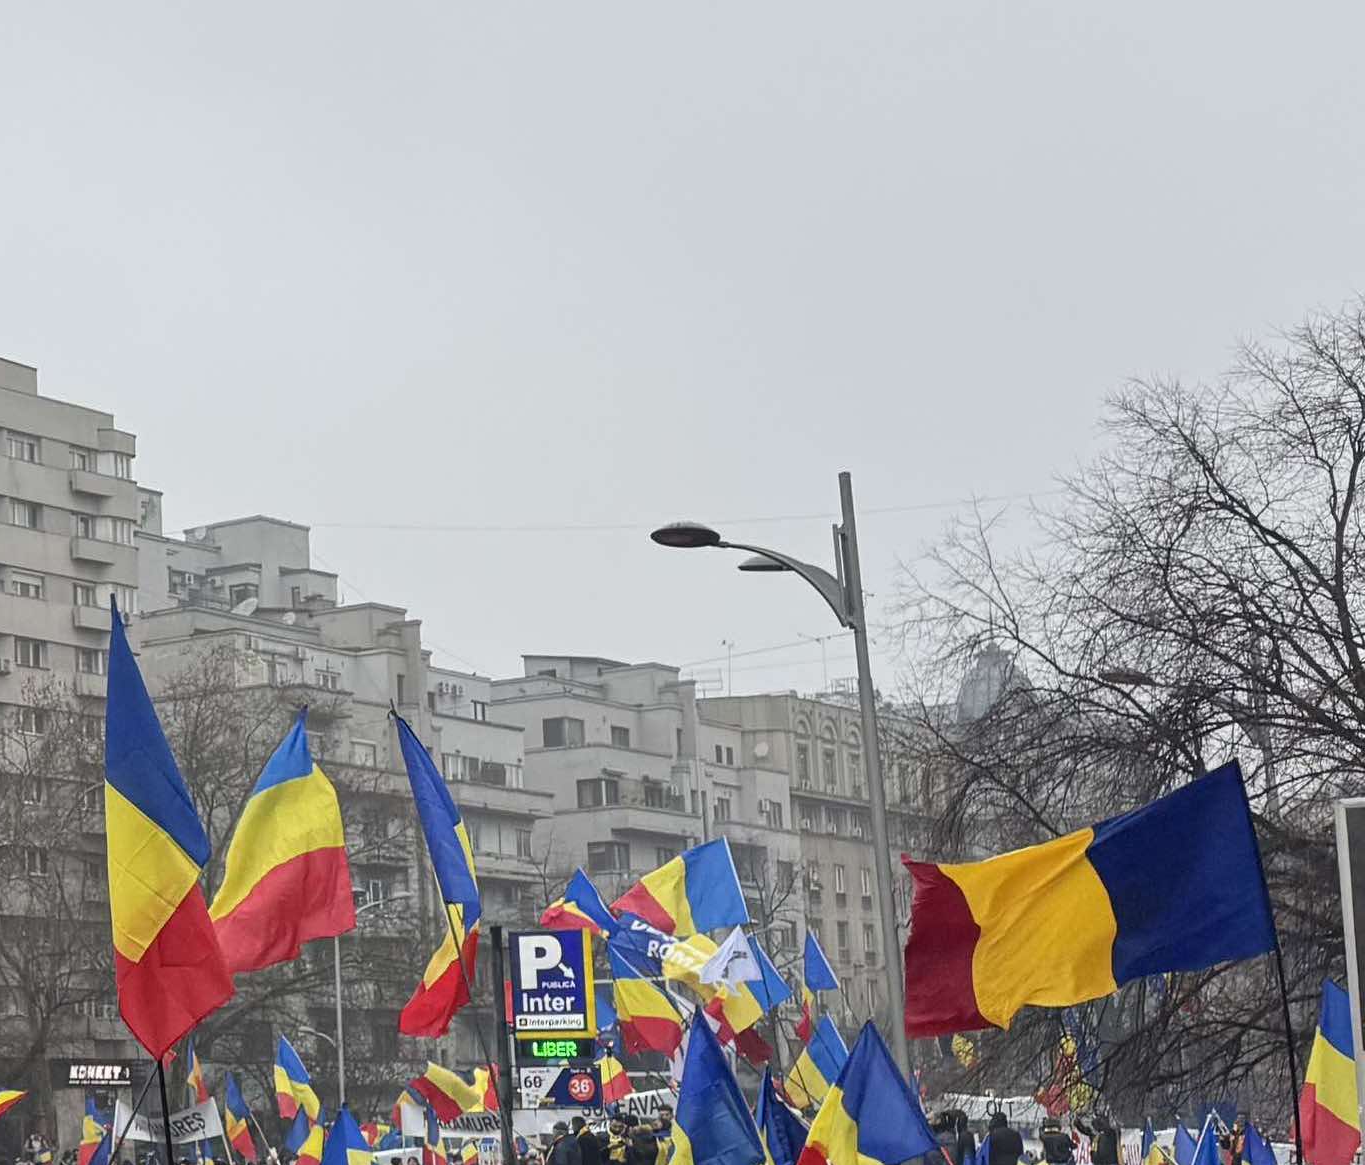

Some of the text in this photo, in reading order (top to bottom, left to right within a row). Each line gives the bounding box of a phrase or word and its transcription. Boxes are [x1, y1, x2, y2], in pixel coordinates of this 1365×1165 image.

[519, 935, 562, 990] P
[522, 992, 576, 1013] Inter
[533, 1041, 578, 1057] LIBER
